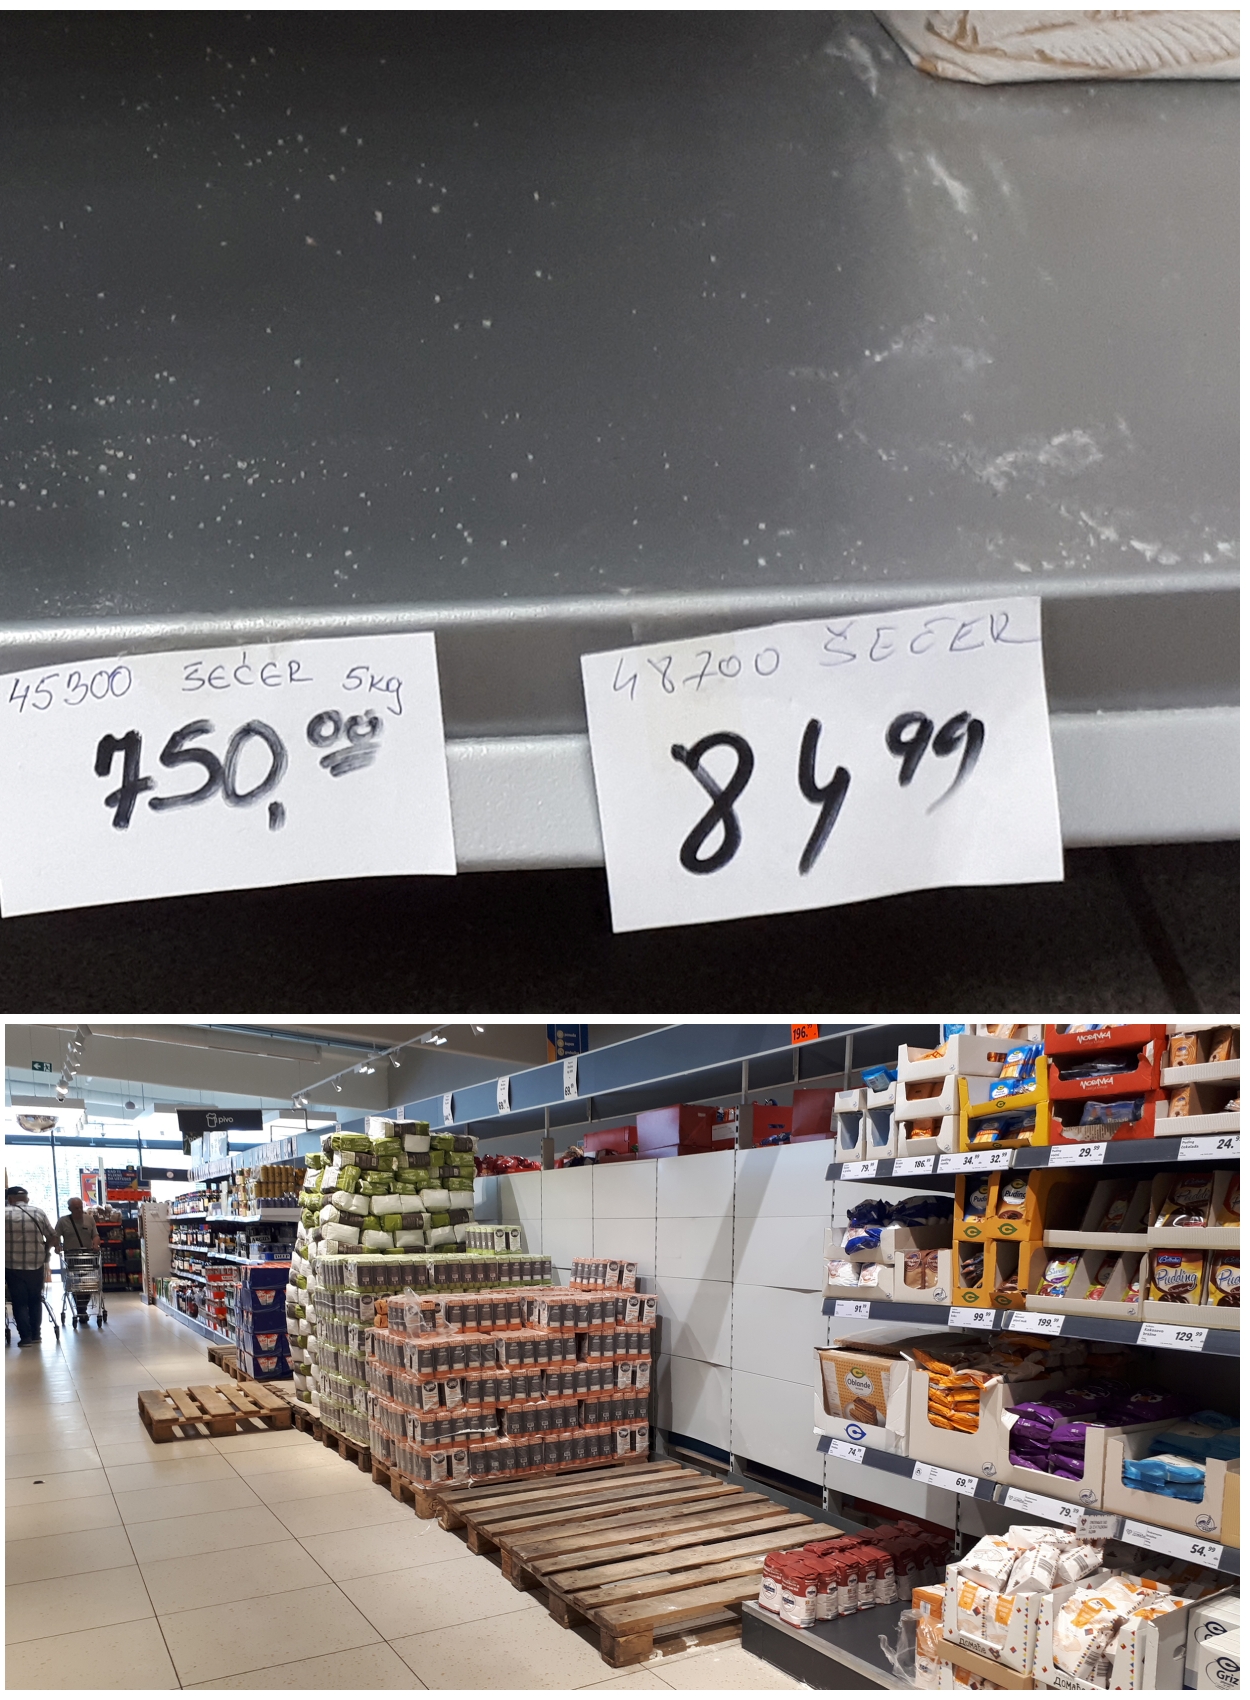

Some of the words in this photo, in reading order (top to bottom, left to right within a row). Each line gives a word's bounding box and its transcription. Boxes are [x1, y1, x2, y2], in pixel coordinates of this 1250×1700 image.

[612, 646, 781, 701] 48700
[8, 664, 133, 714] 45300
[218, 1115, 234, 1125] pivo
[1156, 1268, 1198, 1291] Pudding
[1174, 1331, 1194, 1342] 129.
[847, 1378, 871, 1389] Oblande
[1190, 1543, 1206, 1557] 54.
[1216, 1669, 1240, 1686] Griz
